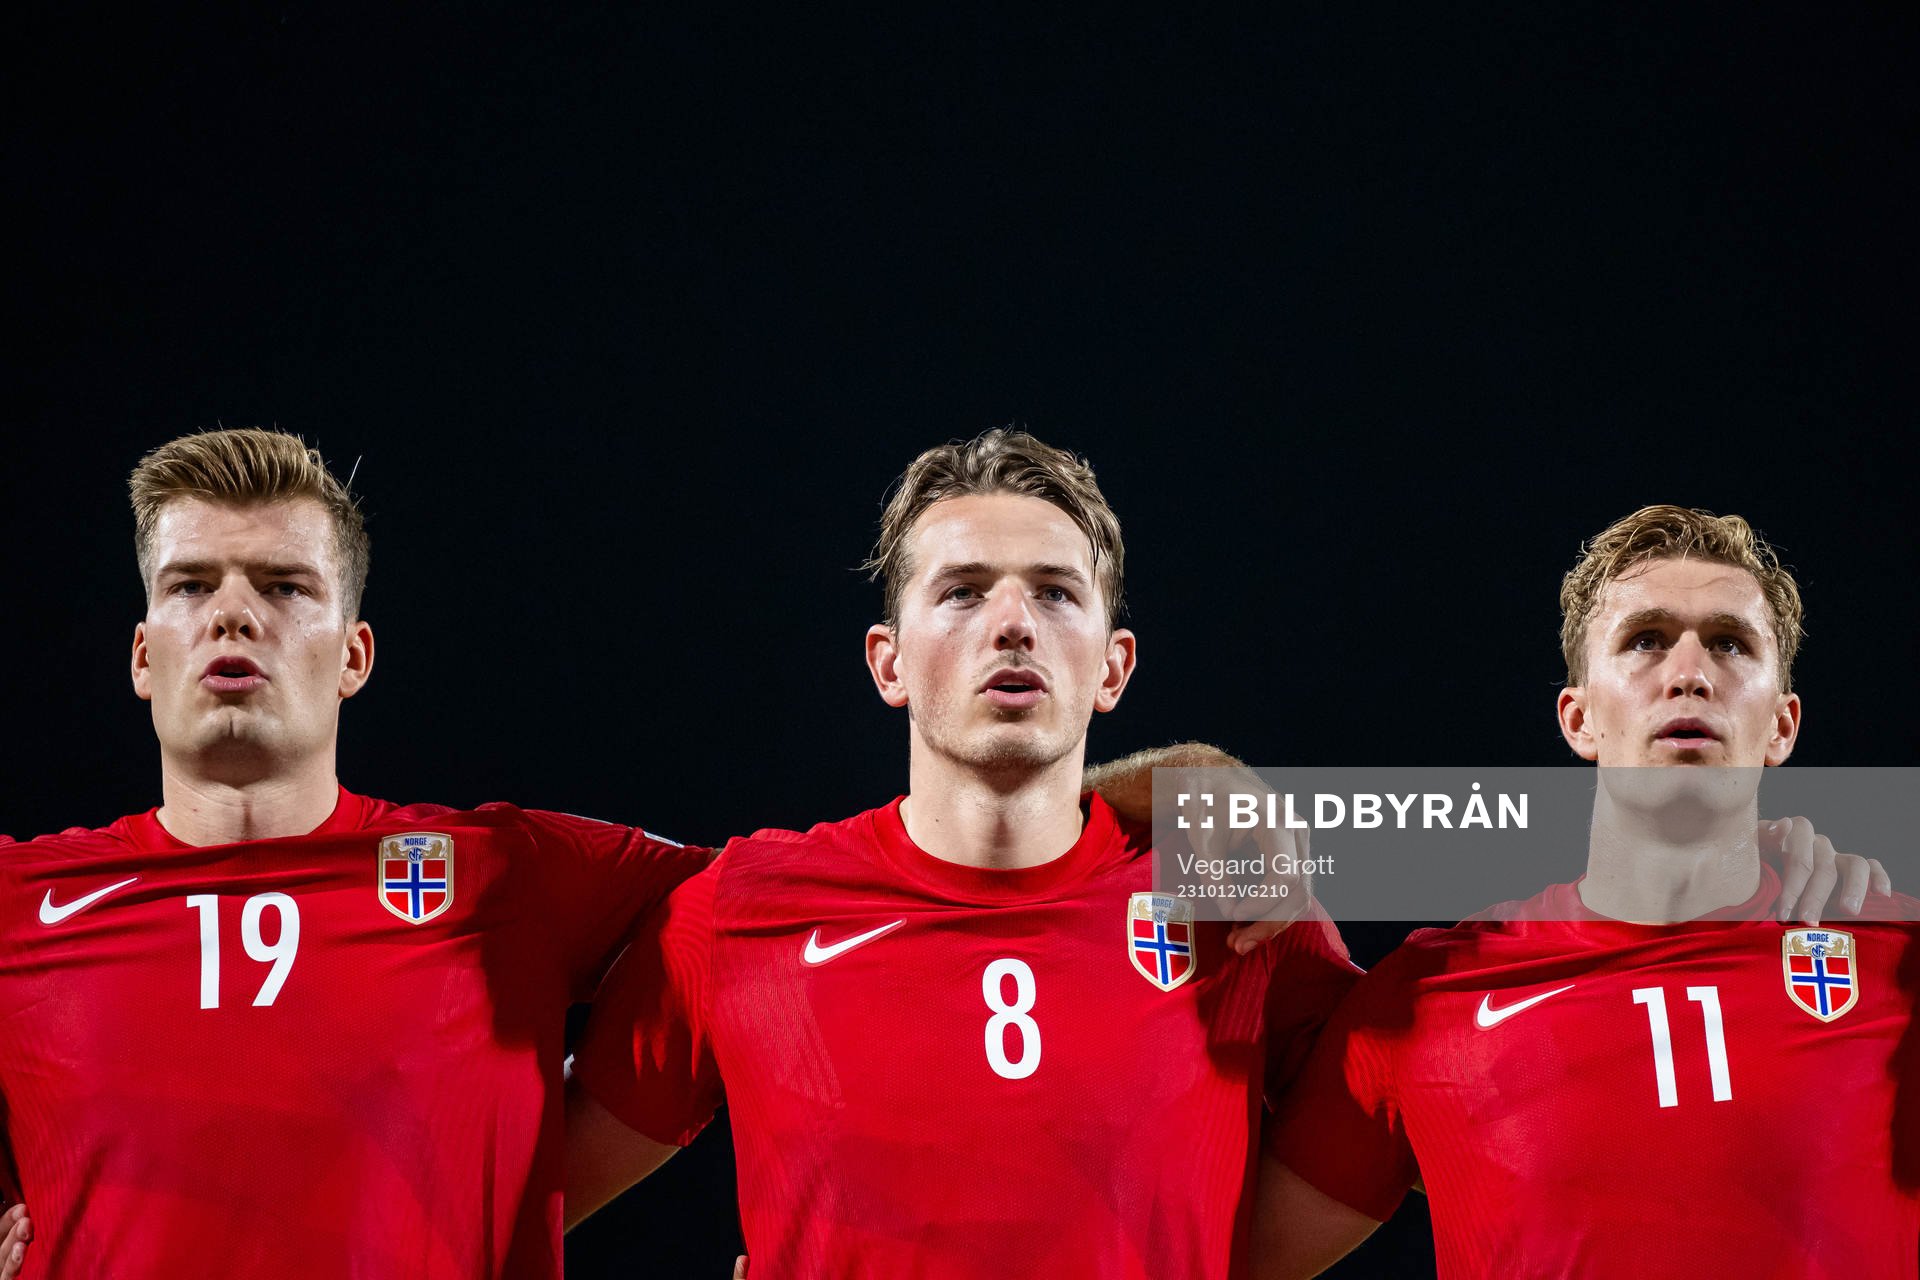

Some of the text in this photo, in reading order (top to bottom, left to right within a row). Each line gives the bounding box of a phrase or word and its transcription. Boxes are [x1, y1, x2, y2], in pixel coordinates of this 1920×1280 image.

[404, 837, 428, 846] NORGE
[1152, 897, 1173, 908] NORGE
[187, 892, 300, 1009] 19
[1807, 933, 1830, 942] NORGE
[982, 958, 1041, 1080] 8
[1632, 986, 1733, 1108] 11
